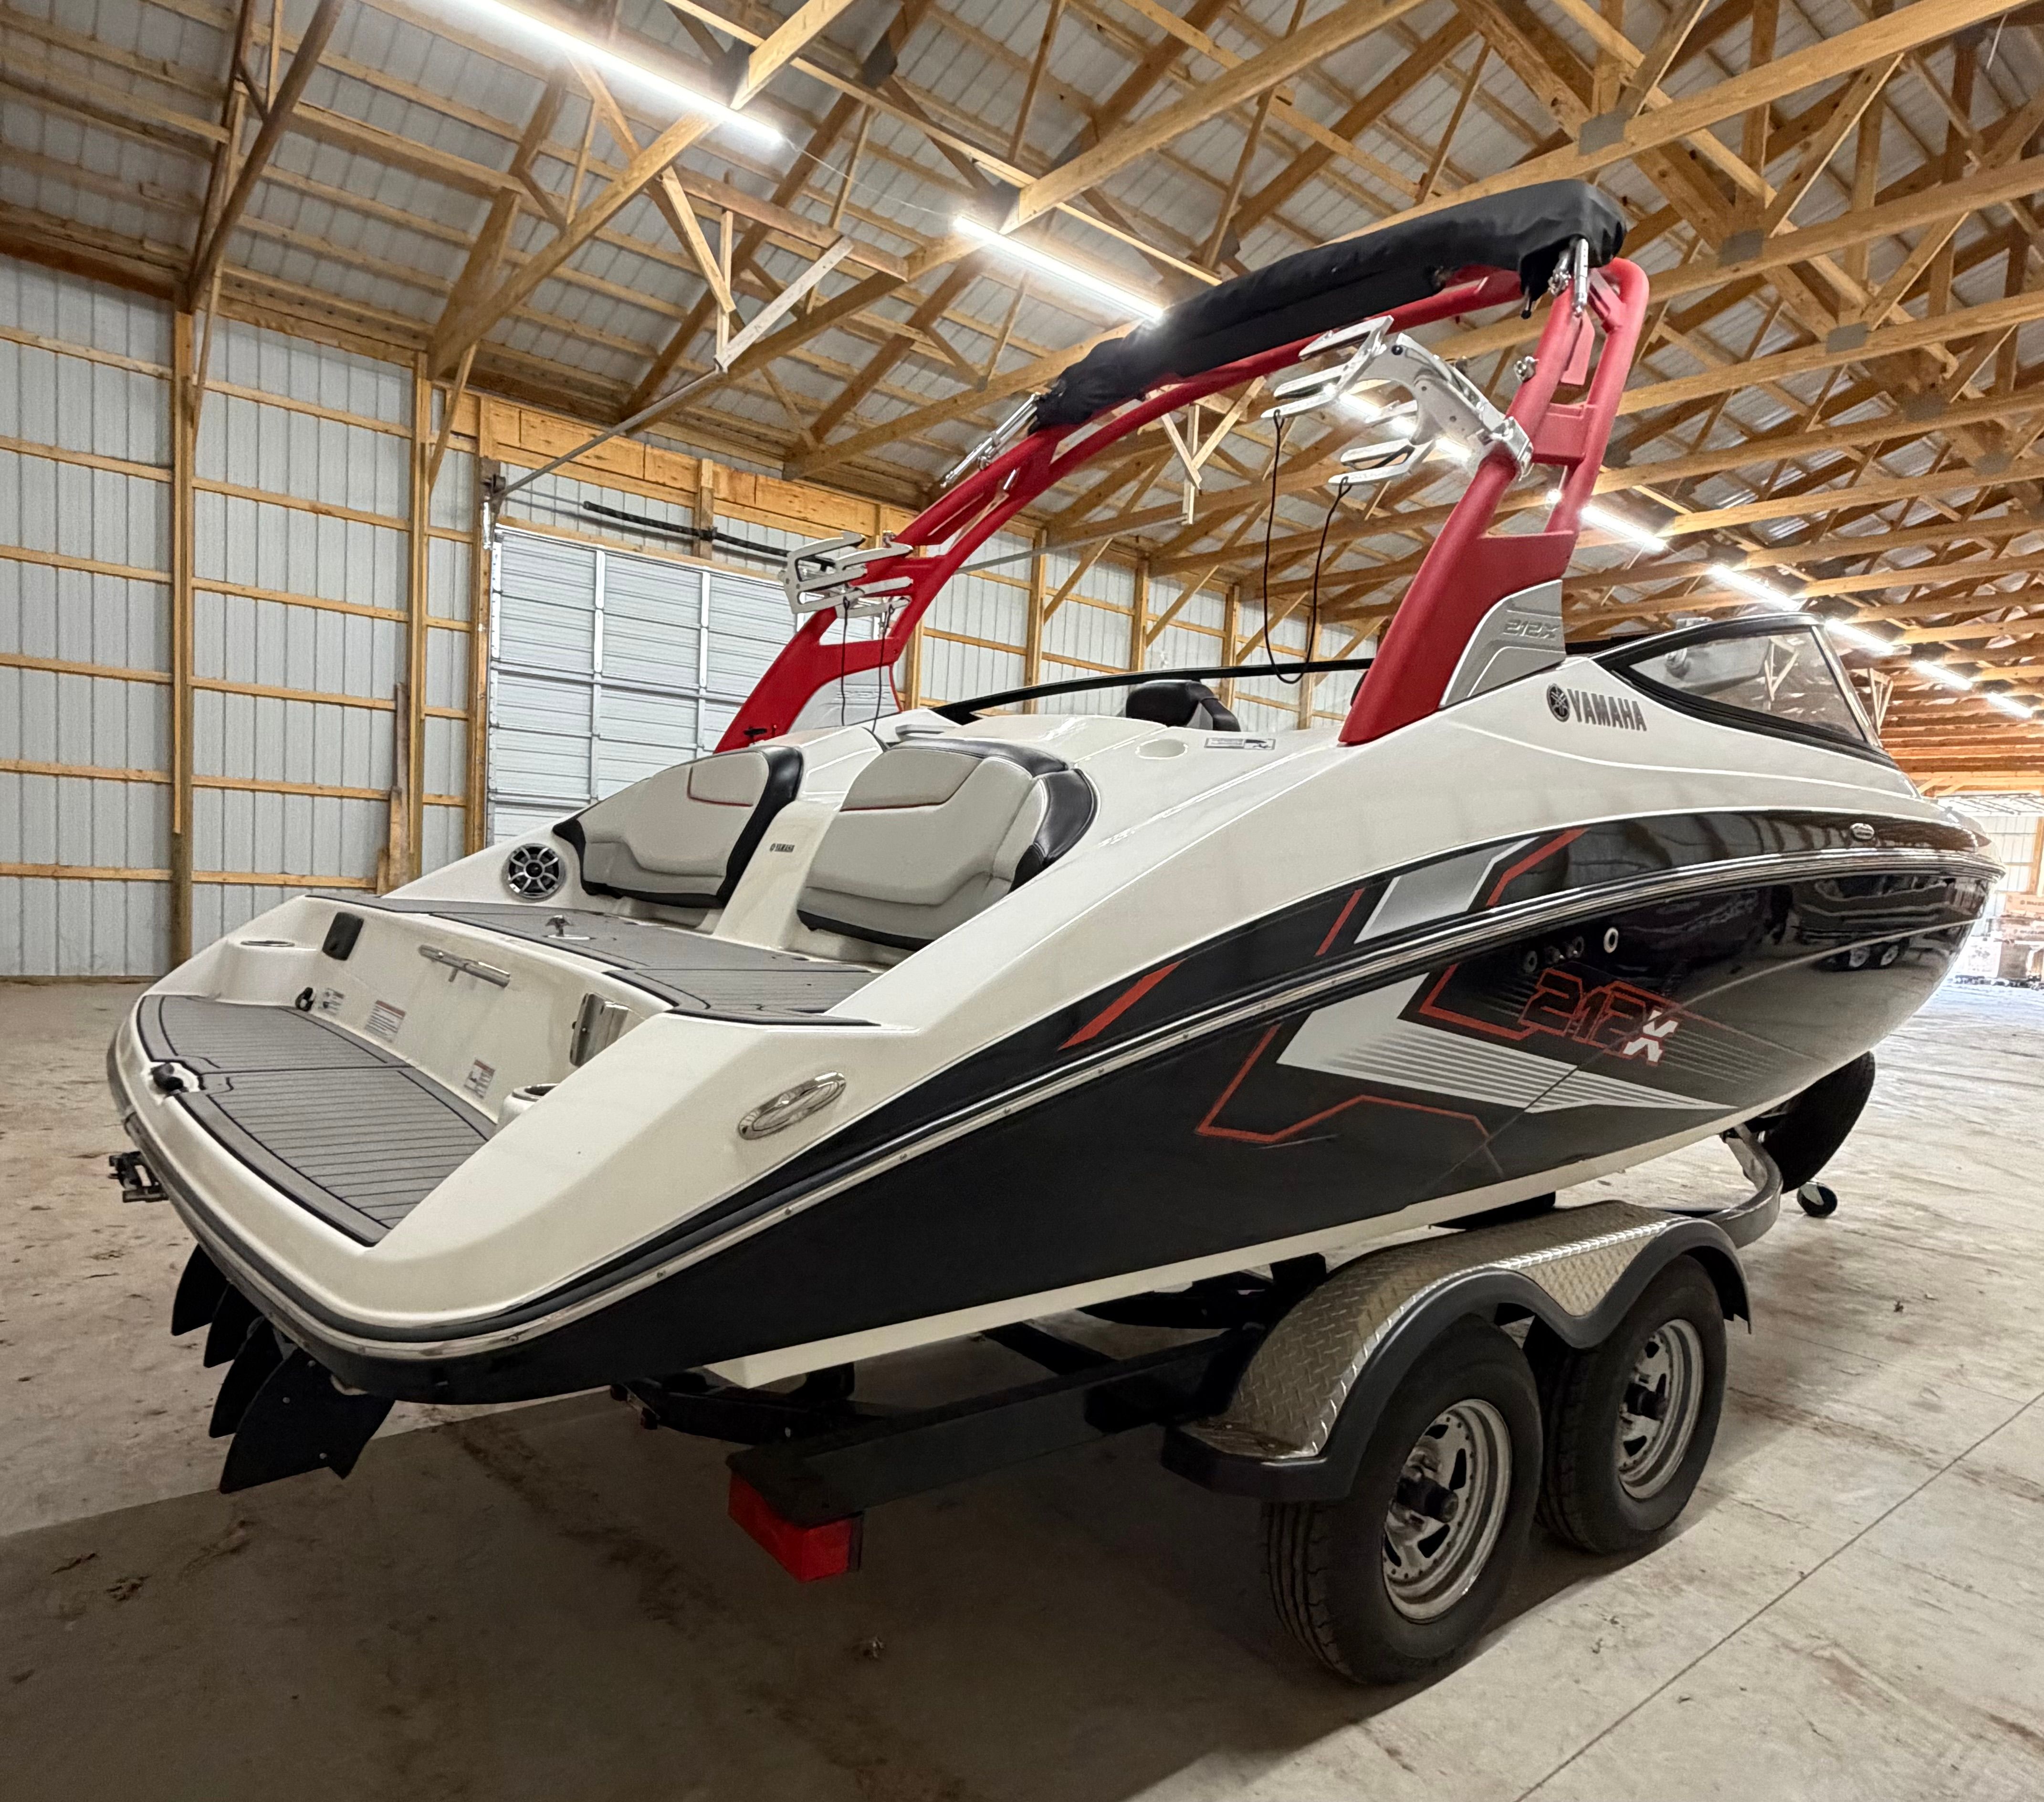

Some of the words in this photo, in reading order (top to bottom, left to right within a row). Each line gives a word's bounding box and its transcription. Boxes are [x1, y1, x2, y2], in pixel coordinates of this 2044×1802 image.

[1503, 619, 1560, 640] 212X
[1567, 688, 1647, 731] YAMAHA
[1518, 967, 1681, 1066] 212X
